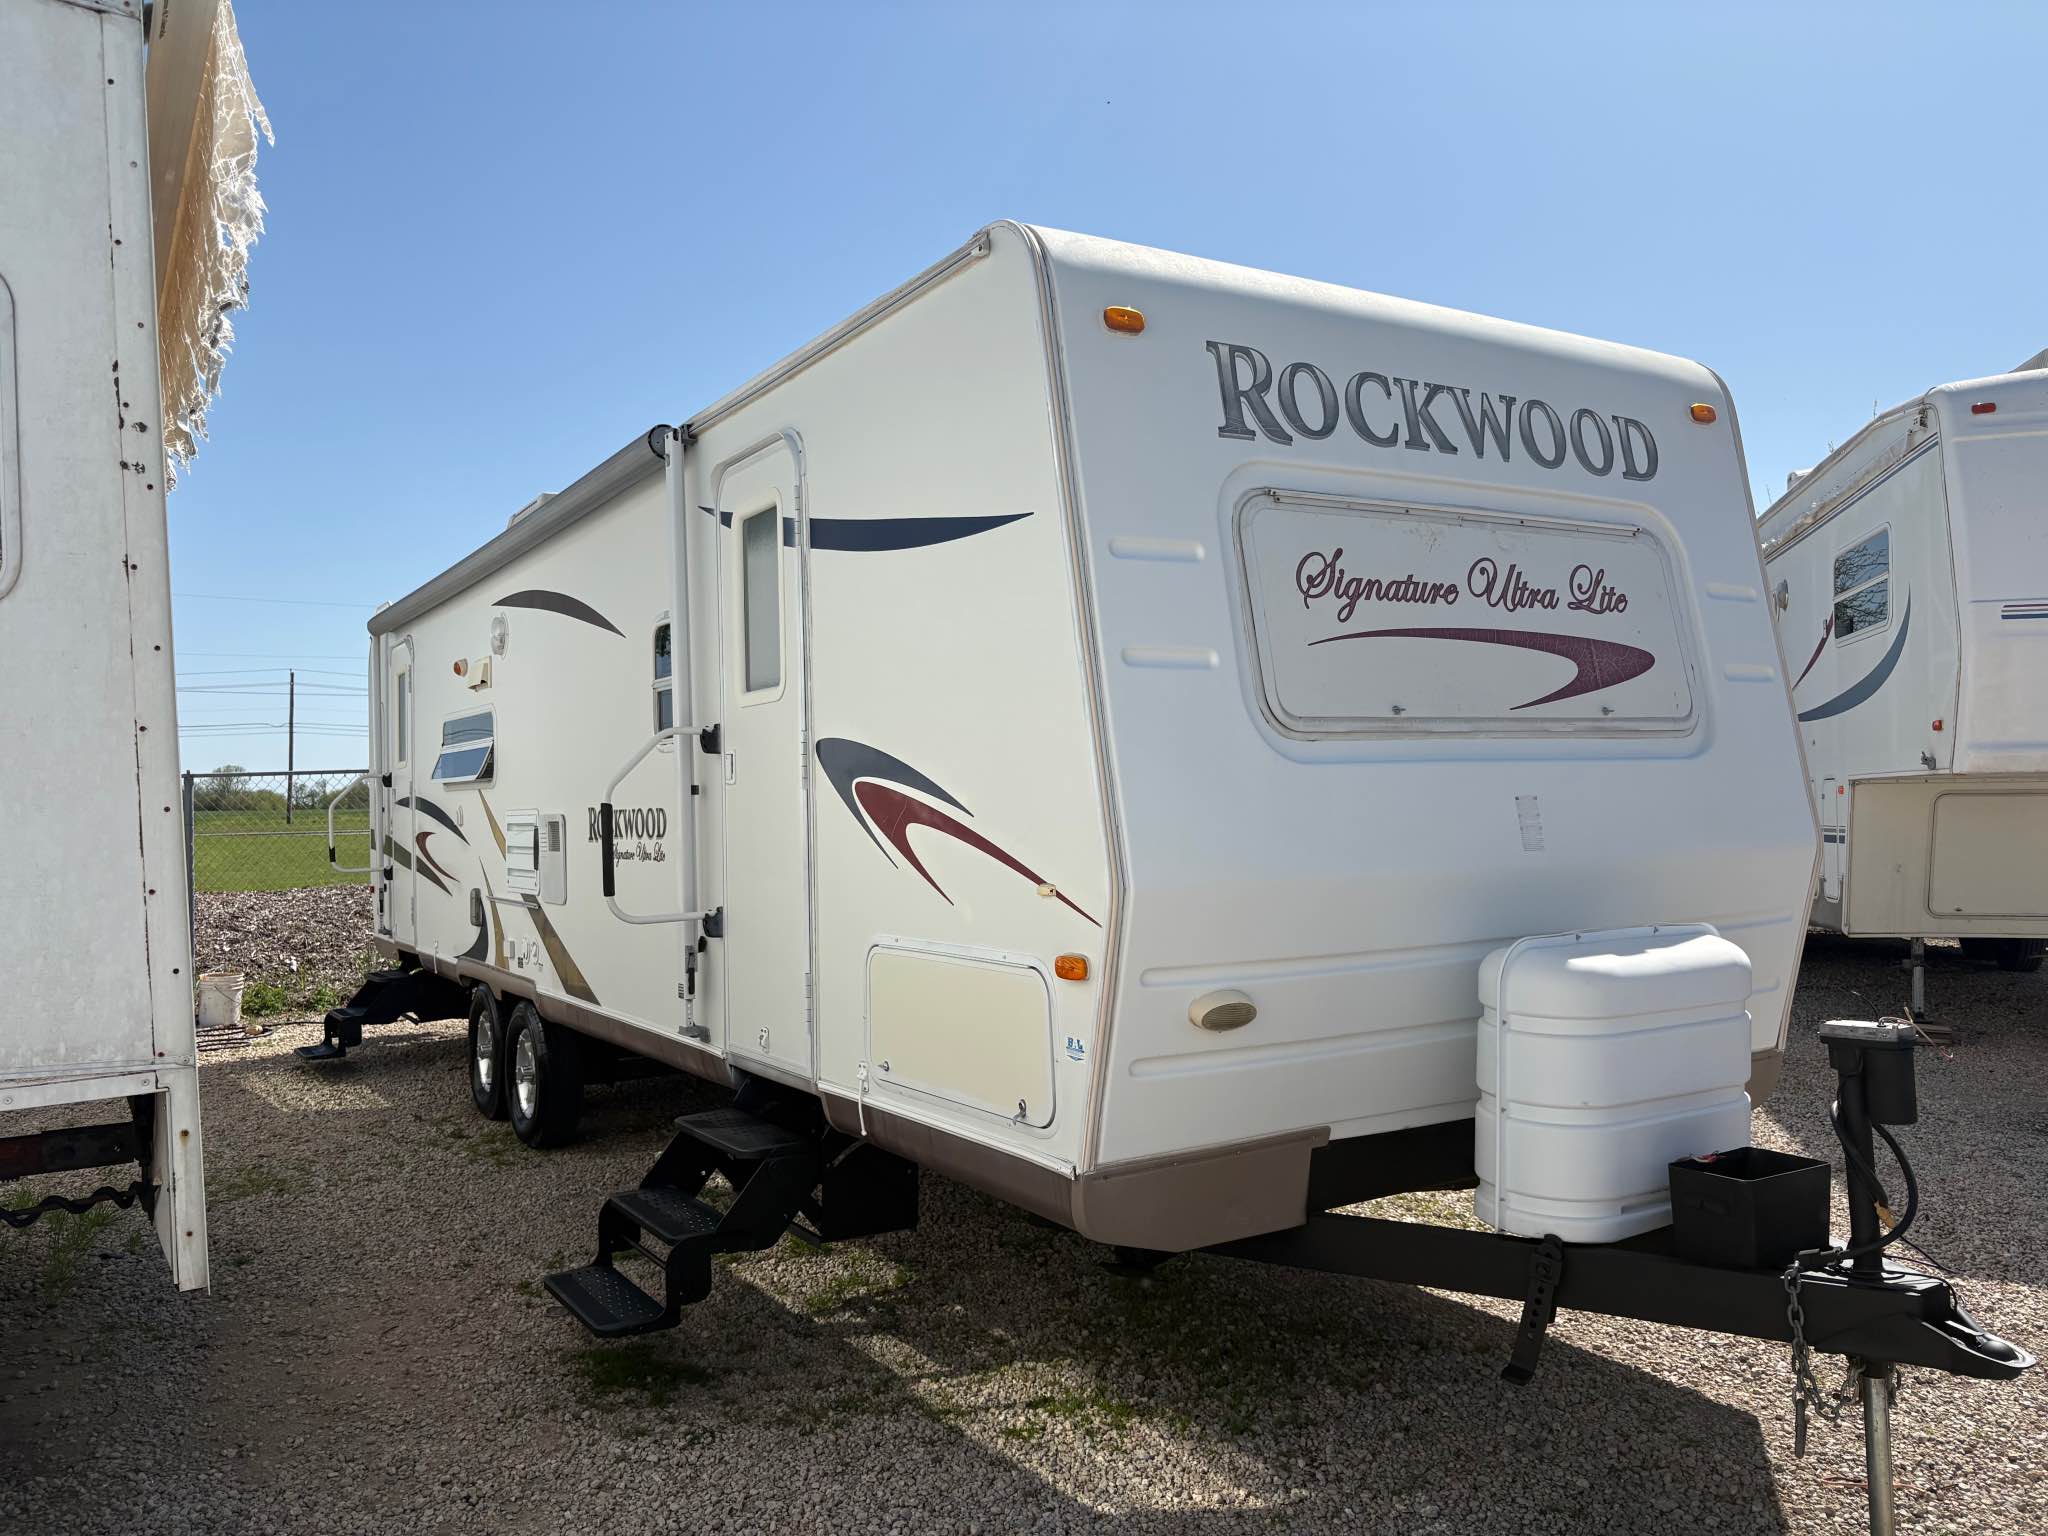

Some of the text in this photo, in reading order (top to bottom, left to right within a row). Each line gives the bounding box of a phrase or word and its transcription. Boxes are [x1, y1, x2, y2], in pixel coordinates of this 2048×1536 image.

[1206, 339, 1659, 482] ROCKWOOD
[1296, 547, 1628, 623] Signature Ultra Lite
